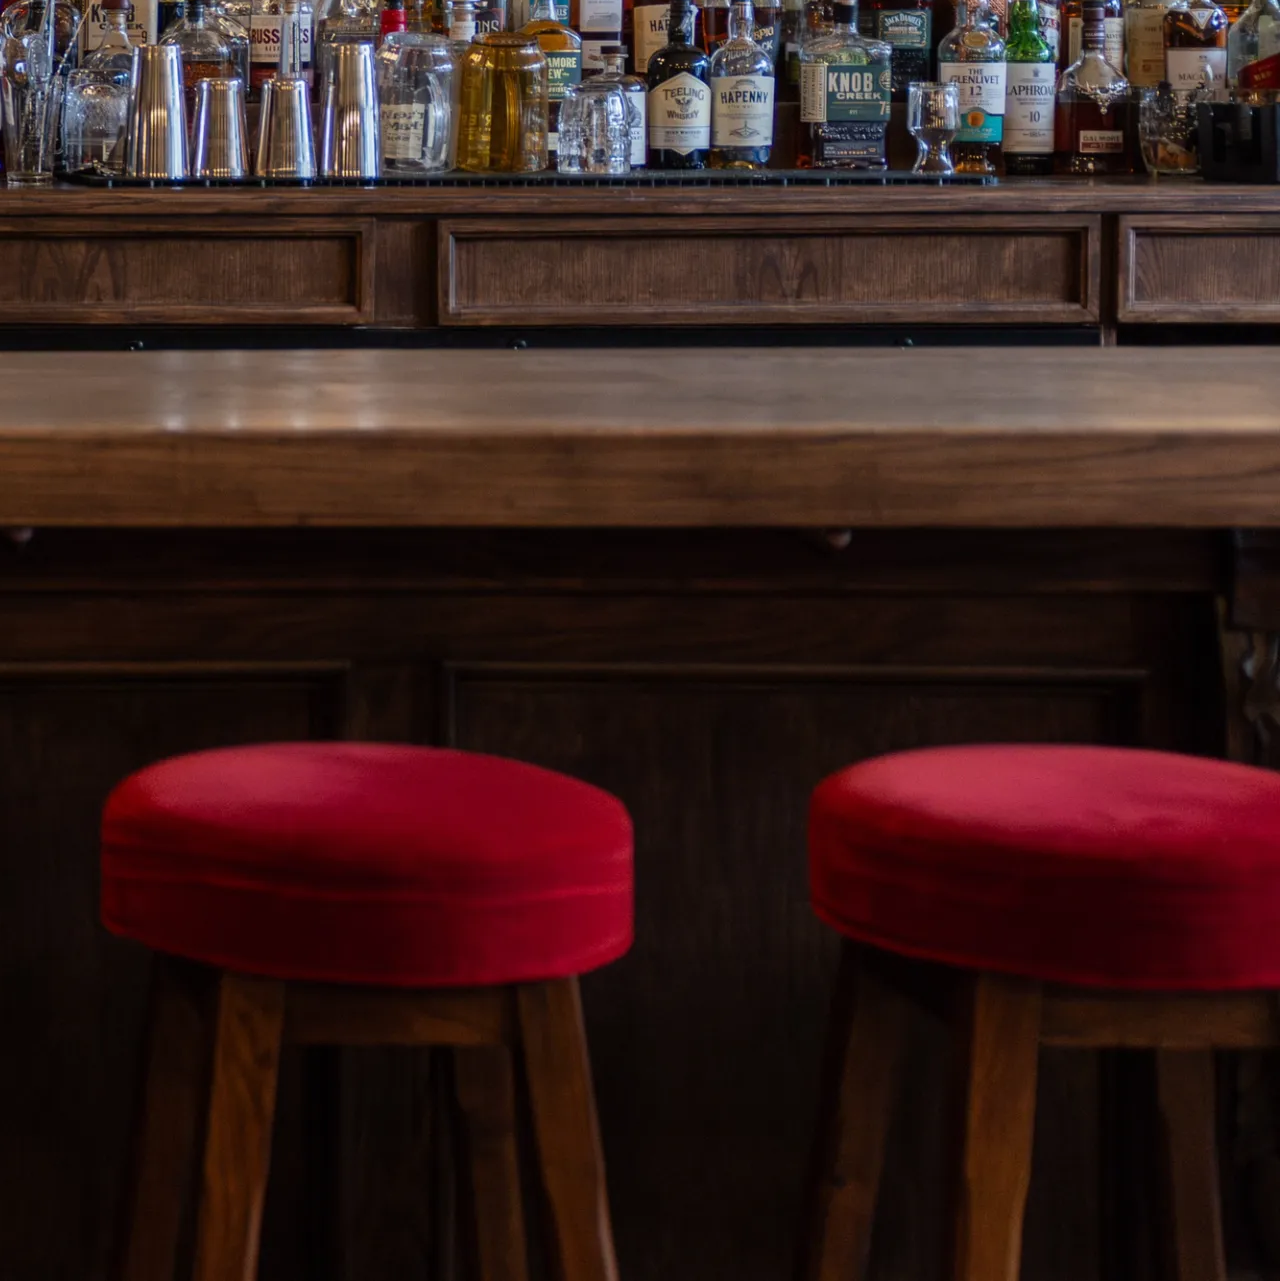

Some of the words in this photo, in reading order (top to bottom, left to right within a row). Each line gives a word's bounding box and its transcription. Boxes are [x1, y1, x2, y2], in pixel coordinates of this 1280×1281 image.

[884, 14, 899, 27] JACK
[141, 30, 148, 45] 9
[828, 72, 874, 93] KNOB
[950, 75, 999, 85] GLENLIVET
[662, 87, 704, 101] TEELING
[720, 89, 769, 105] HAPENNY
[836, 92, 882, 100] CREEK
[970, 86, 983, 96] 12
[666, 110, 699, 119] WHISKEY
[879, 100, 886, 116] 7
[1029, 111, 1041, 122] 10
